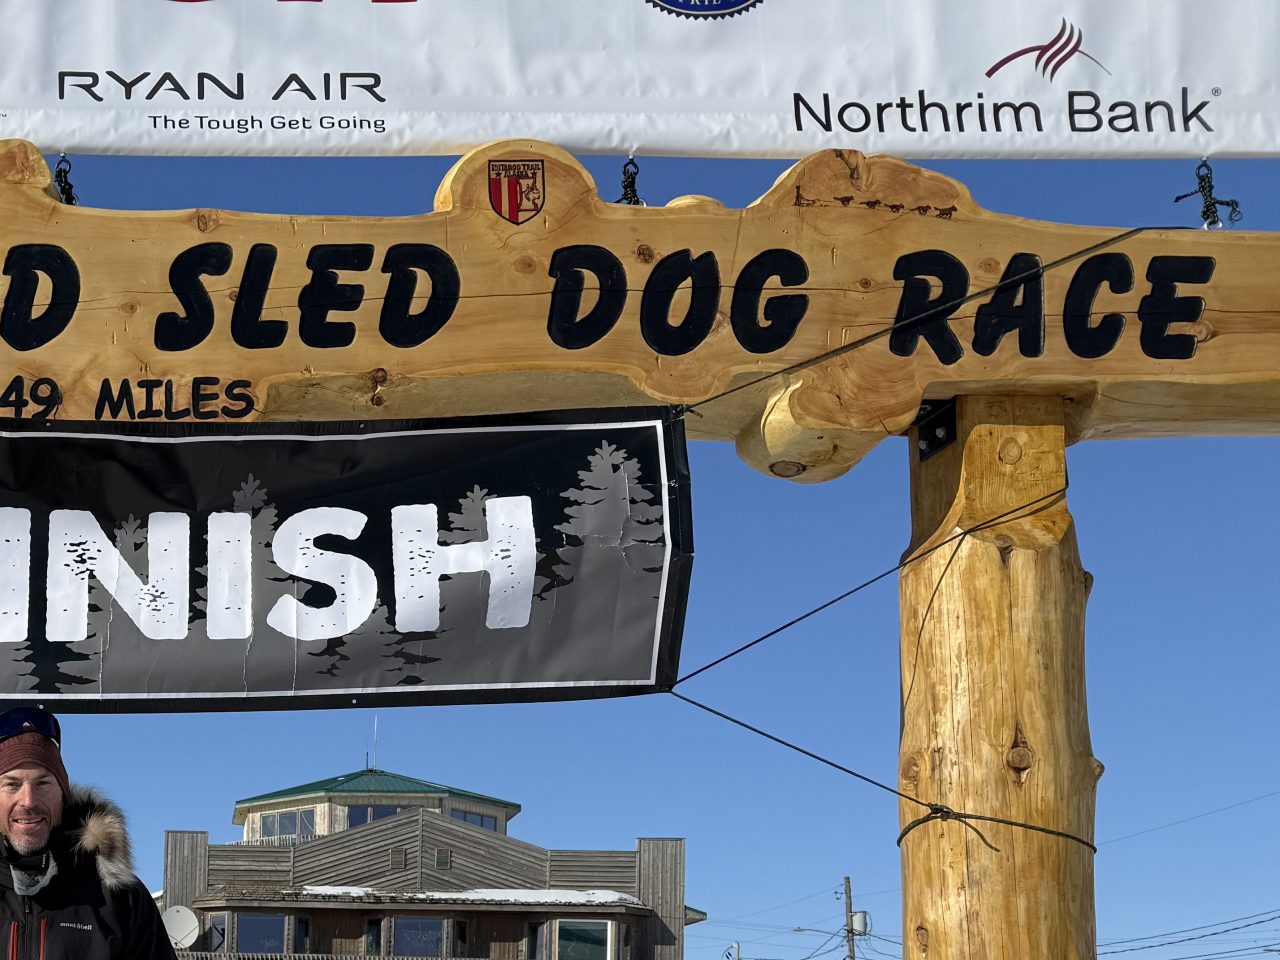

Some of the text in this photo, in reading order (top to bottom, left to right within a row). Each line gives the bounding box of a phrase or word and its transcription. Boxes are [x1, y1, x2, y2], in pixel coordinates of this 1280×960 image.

[58, 71, 386, 103] RYAN AIR
[148, 115, 386, 133] The Tough Get Going
[793, 90, 1043, 132] Northrim
[154, 243, 461, 351] SLED
[547, 244, 810, 357] DOG
[889, 250, 1217, 366] RACE
[96, 376, 256, 420] MILES
